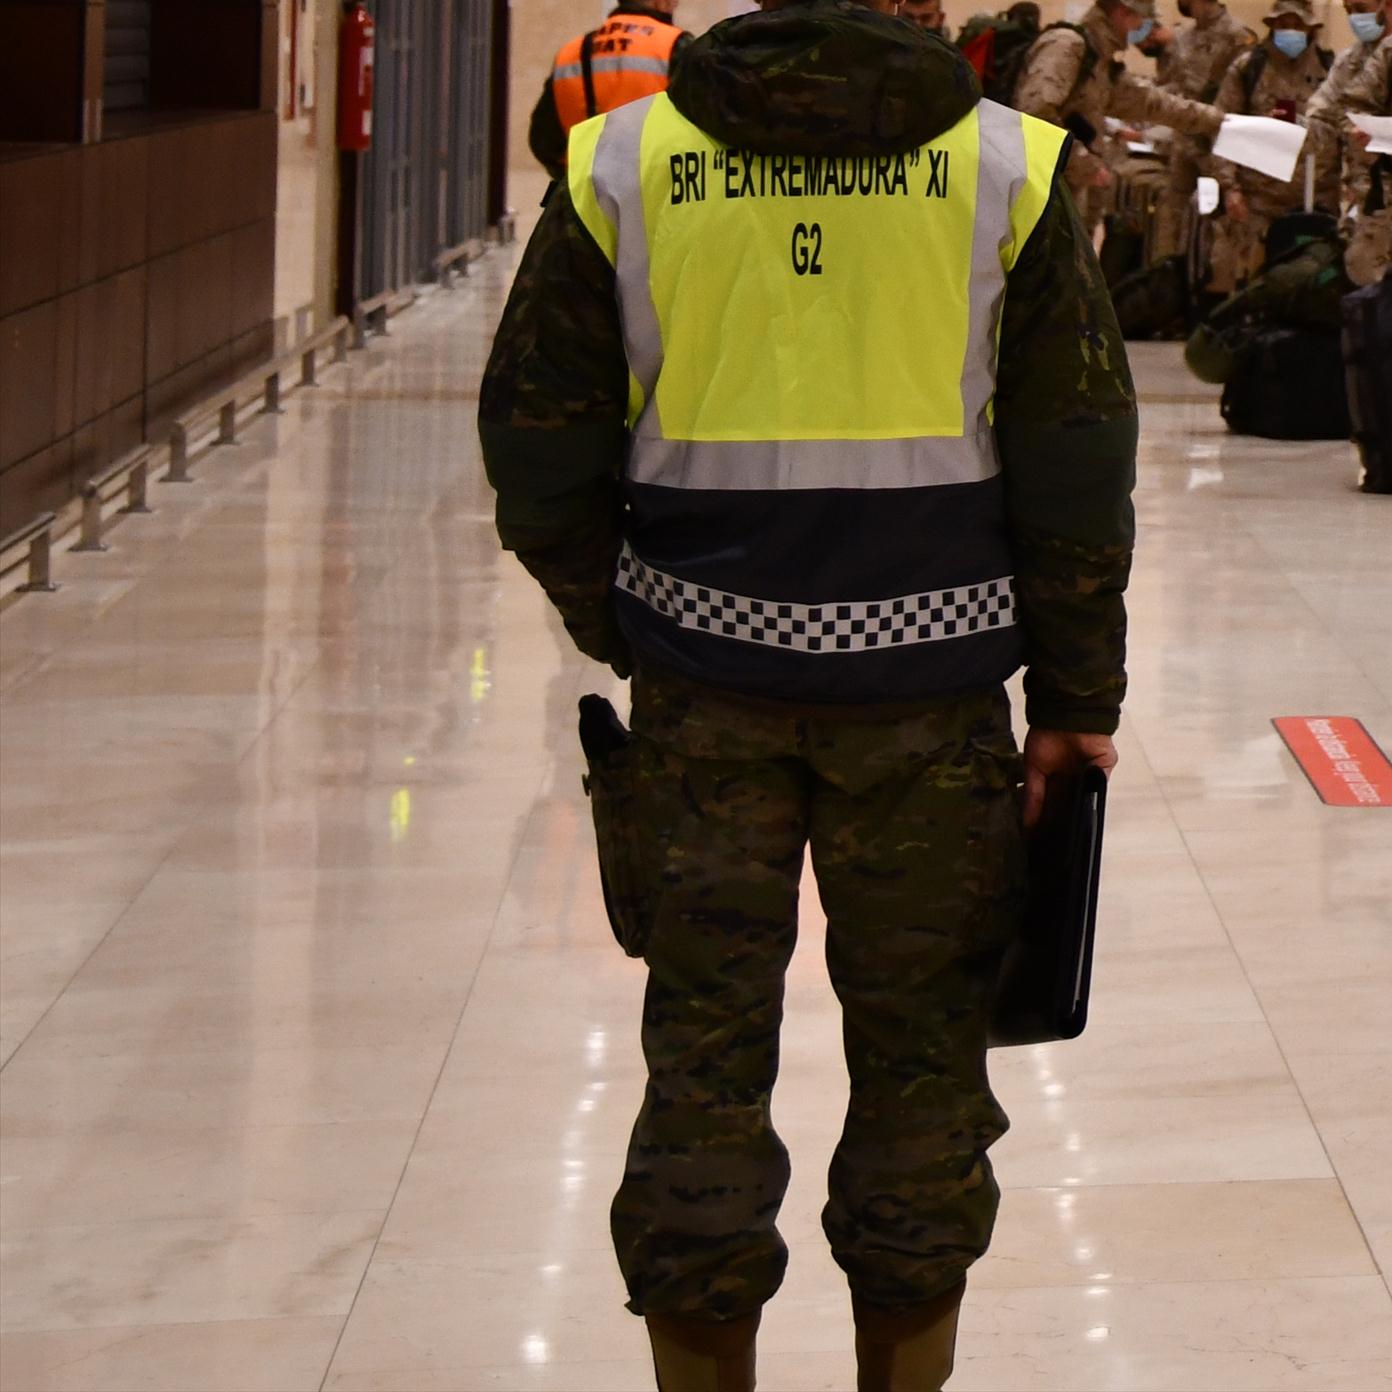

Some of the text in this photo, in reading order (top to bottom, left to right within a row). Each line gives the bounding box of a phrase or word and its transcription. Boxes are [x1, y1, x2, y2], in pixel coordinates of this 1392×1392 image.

[670, 150, 706, 205] BRI
[925, 149, 949, 199] XI
[791, 222, 822, 275] G2
